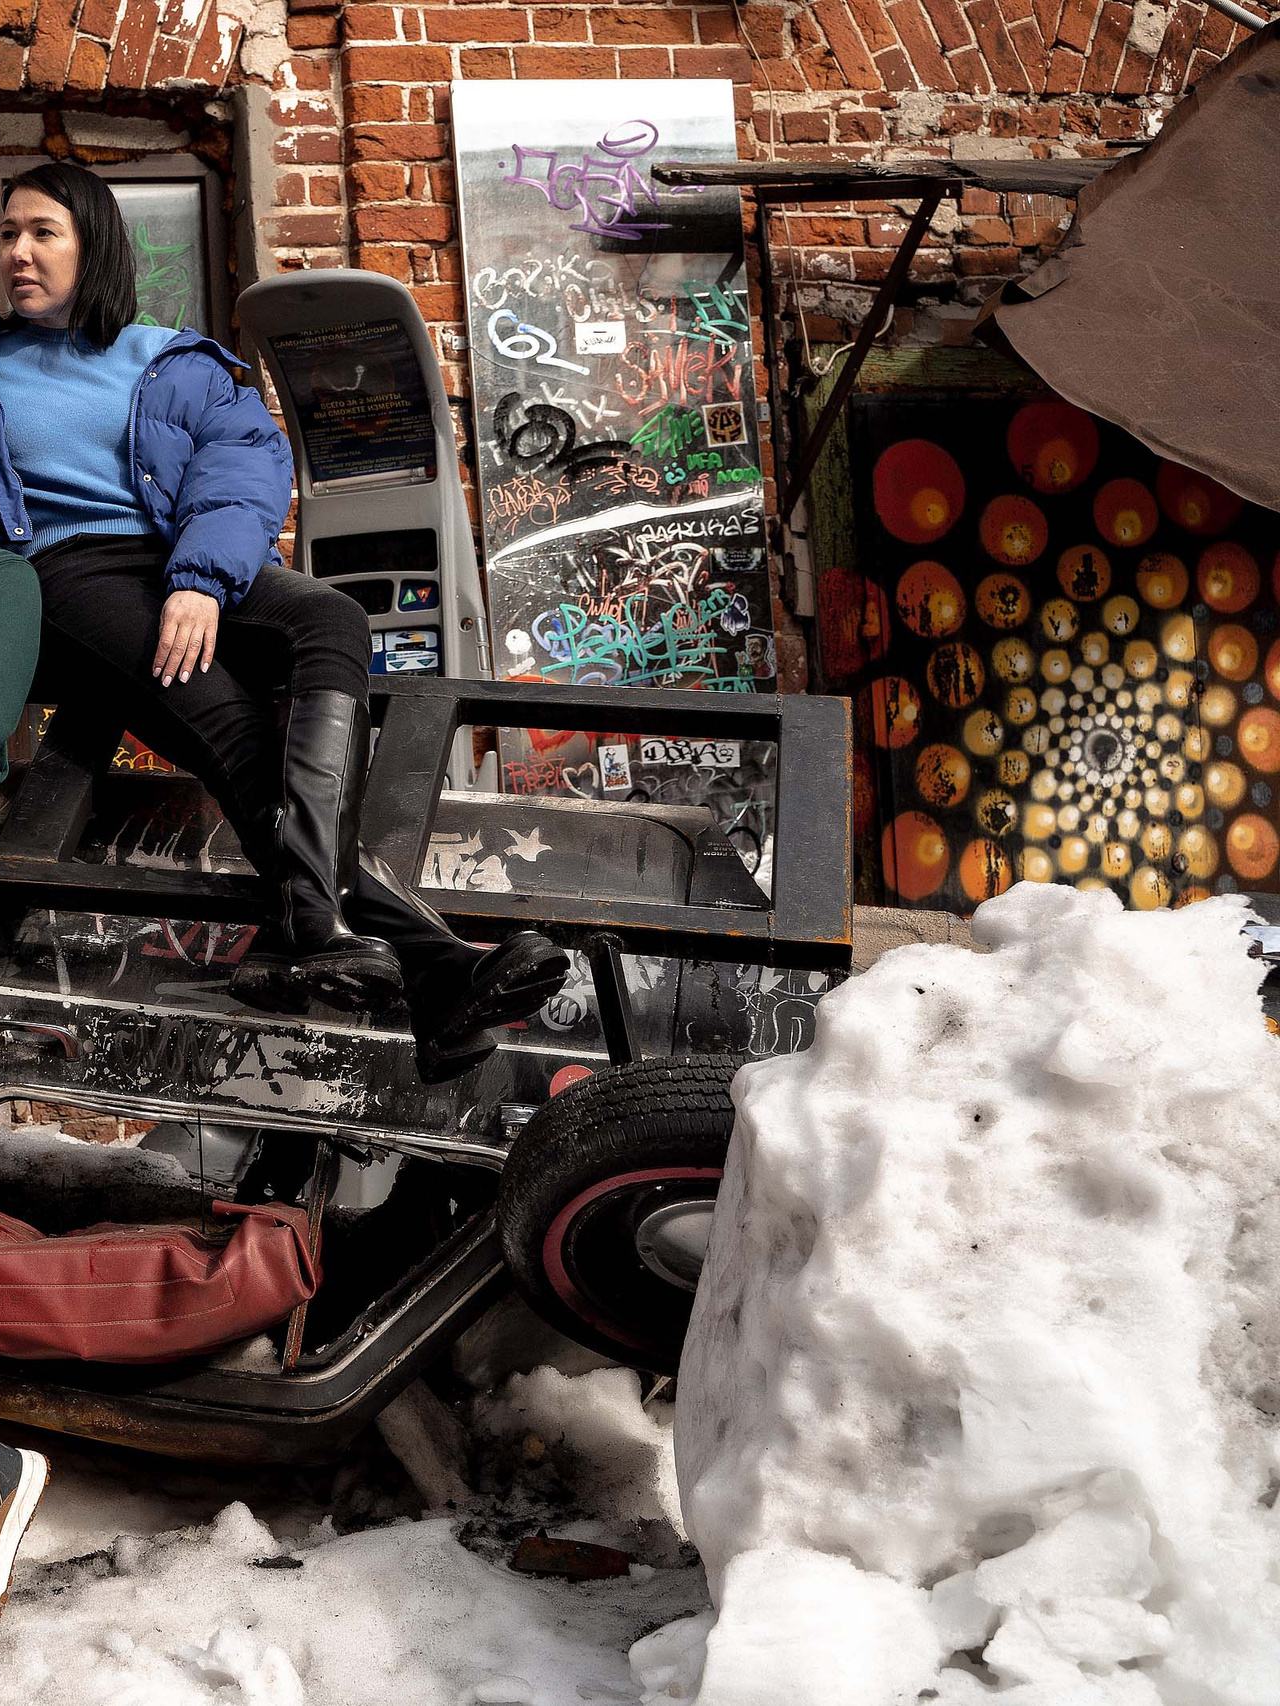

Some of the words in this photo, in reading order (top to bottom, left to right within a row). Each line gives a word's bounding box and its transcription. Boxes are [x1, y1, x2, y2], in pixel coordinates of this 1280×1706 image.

[273, 332, 347, 348] САМОКОНТРОЛЬ
[347, 324, 399, 340] ЗДОРОВЬЯ
[320, 400, 346, 410] ВСЕГО
[366, 392, 402, 404] МИНУТЫ
[313, 411, 327, 420] ВЫ
[328, 405, 366, 418] СМОЖЕТЕ
